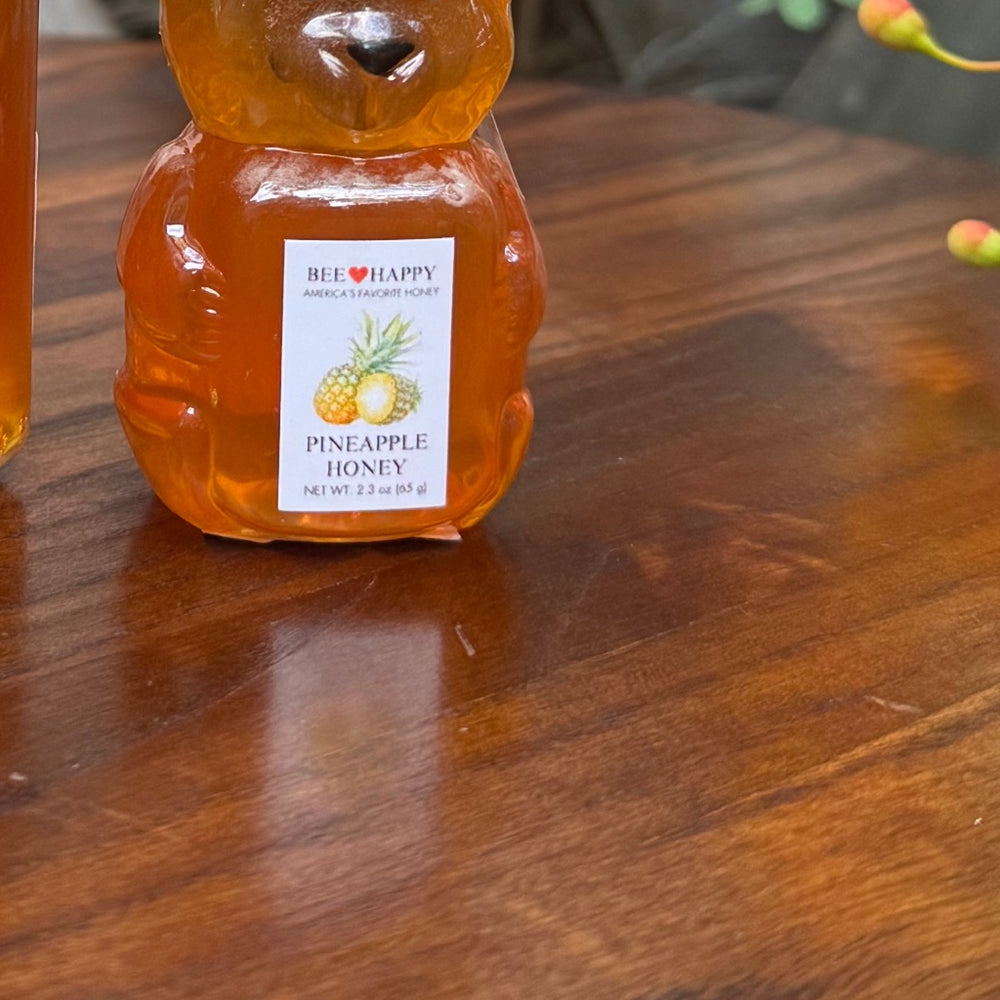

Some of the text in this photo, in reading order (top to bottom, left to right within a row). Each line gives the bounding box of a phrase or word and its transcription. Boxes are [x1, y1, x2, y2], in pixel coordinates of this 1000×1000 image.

[307, 265, 437, 283] BEE HAPPY
[303, 287, 440, 299] AMERICA'S FAVORITE HONEY
[306, 433, 429, 453] PINEAPPLE
[327, 458, 408, 478] HONEY
[304, 484, 327, 496] NET
[357, 483, 375, 496] 2.3
[378, 485, 392, 495] oz
[395, 482, 413, 496] (65
